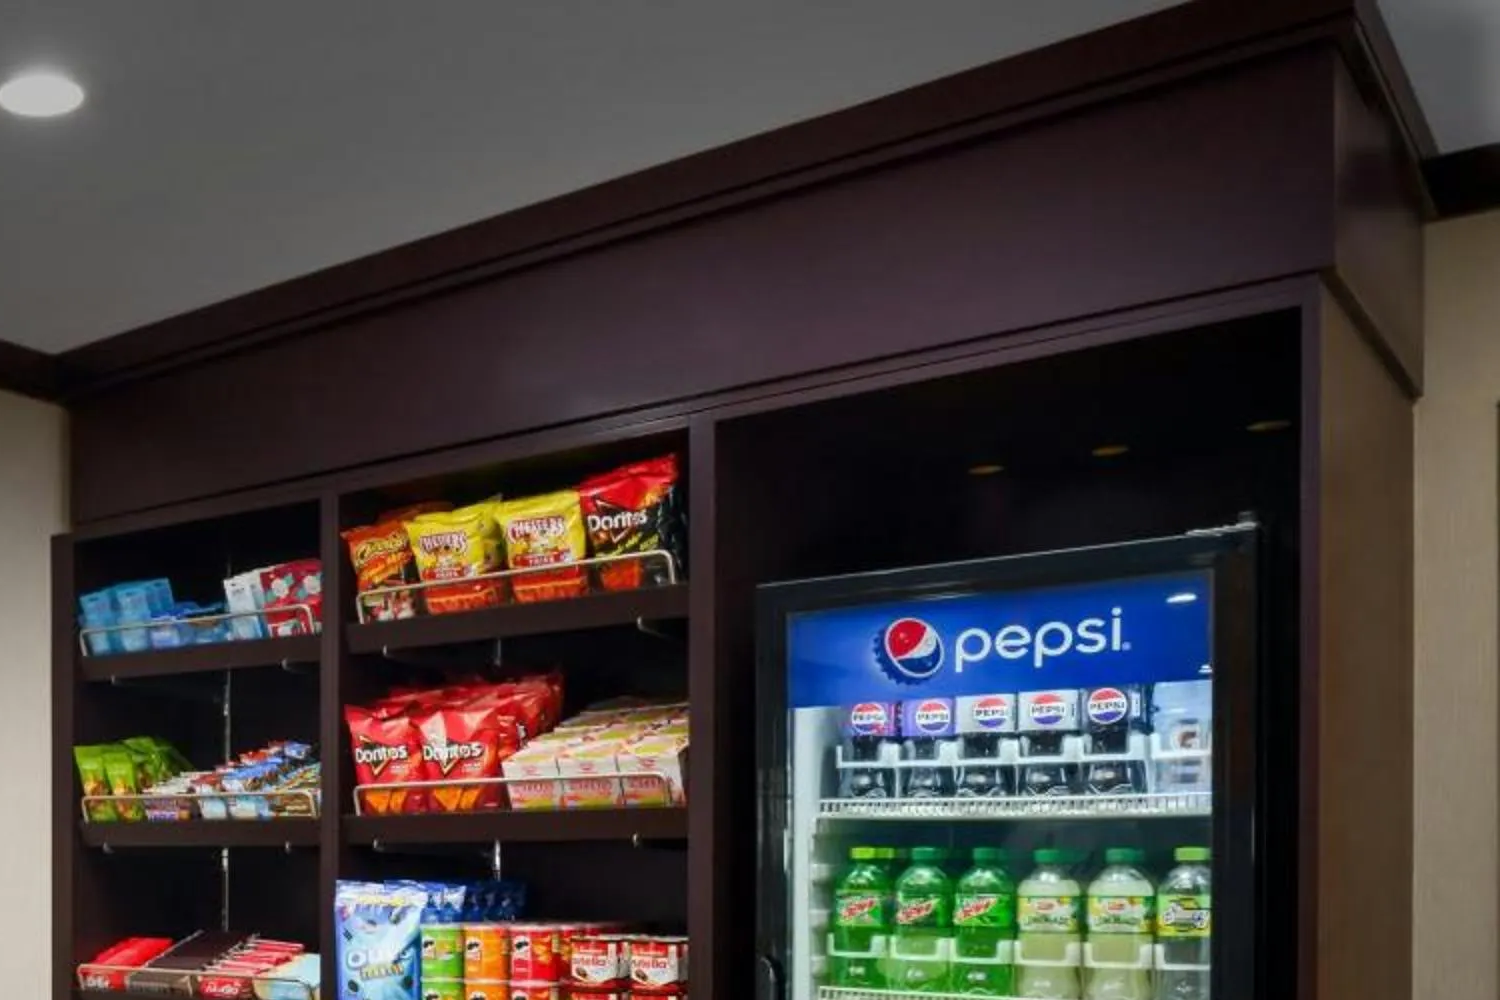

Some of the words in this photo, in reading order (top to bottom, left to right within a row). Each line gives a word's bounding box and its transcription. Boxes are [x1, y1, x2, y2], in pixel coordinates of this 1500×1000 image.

[586, 509, 648, 532] Doritos
[954, 605, 1122, 674] pepsi
[1030, 704, 1064, 715] PEPSI
[1088, 700, 1124, 712] PEPSI
[916, 711, 949, 722] PEPSI
[353, 744, 407, 764] Doritos
[422, 741, 487, 762] Doritos
